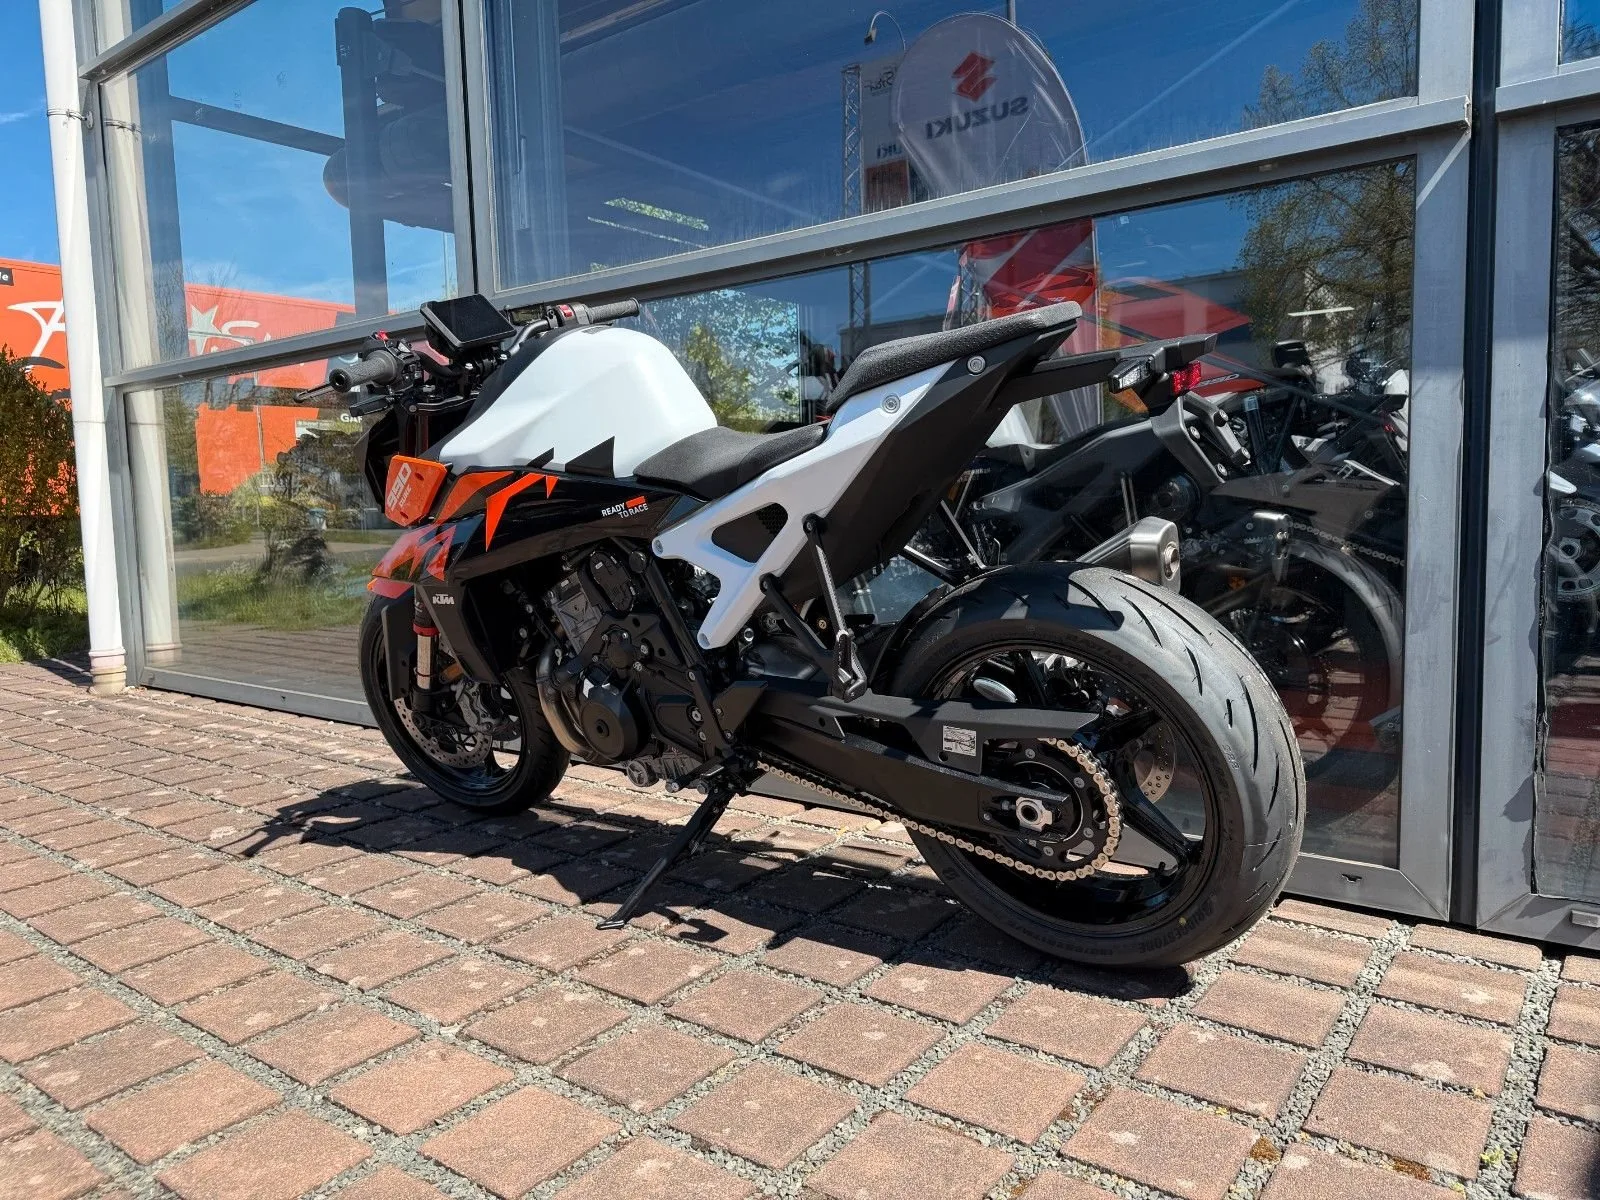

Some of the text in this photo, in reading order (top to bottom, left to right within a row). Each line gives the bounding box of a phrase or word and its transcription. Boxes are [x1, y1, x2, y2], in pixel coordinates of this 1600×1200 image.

[387, 462, 412, 512] 990
[601, 503, 624, 517] READY
[629, 504, 649, 516] RACE
[432, 593, 455, 605] KTM
